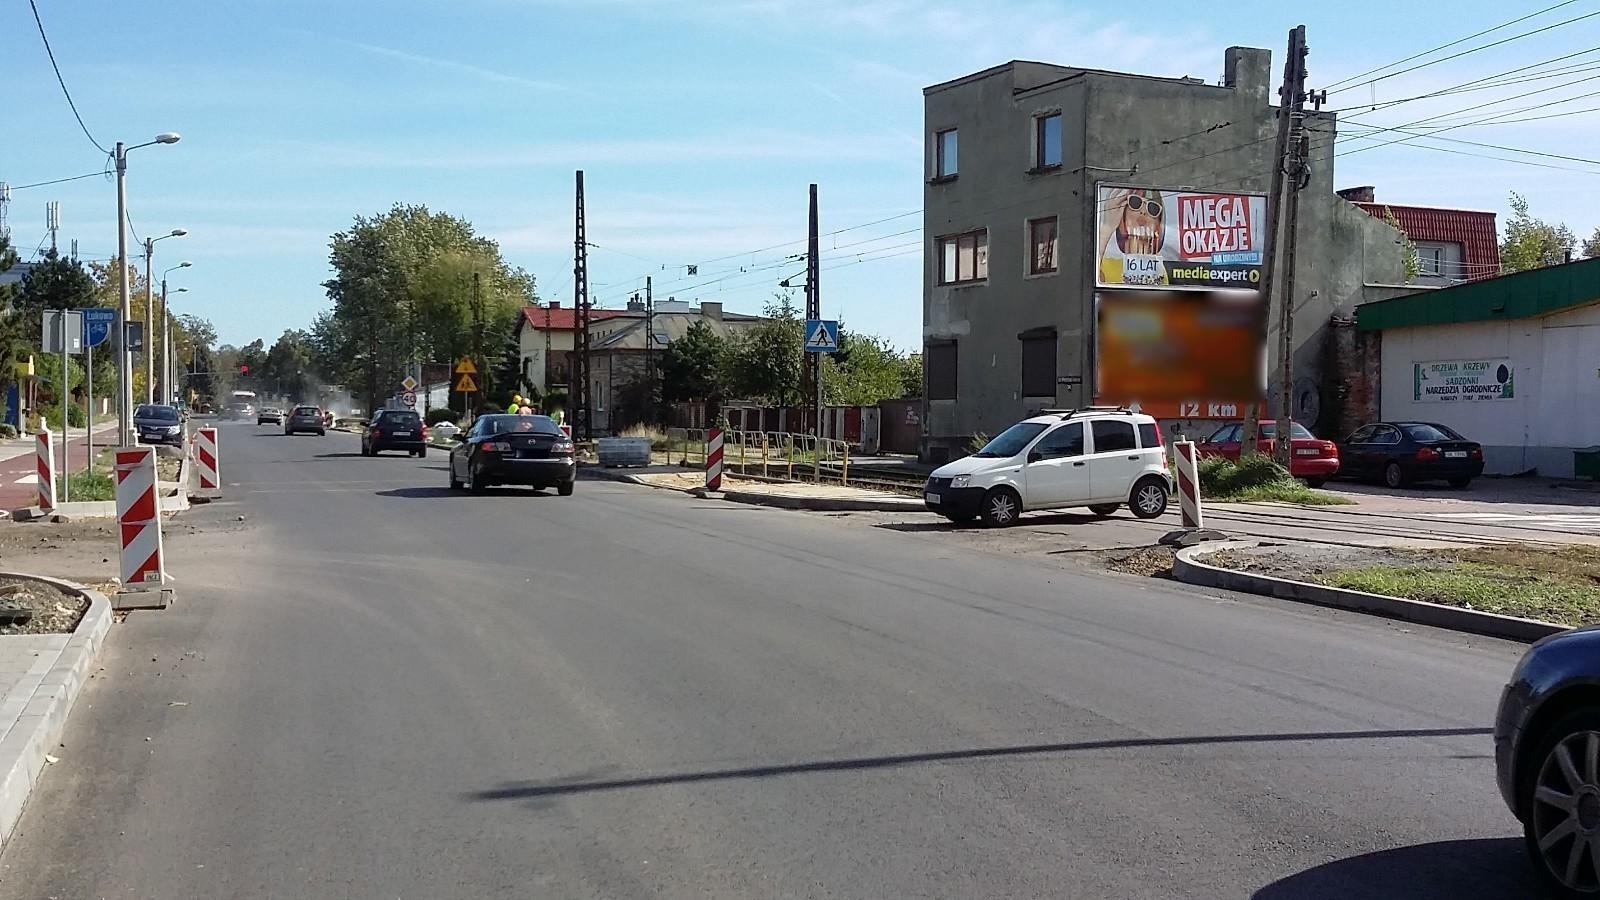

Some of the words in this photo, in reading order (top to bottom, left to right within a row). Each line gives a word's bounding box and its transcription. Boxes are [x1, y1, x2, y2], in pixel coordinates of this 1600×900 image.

[1183, 197, 1246, 229] MEGA
[1183, 228, 1249, 254] OKAZJE
[1127, 258, 1137, 271] 16
[1140, 259, 1159, 271] LAT
[1172, 266, 1248, 282] mediaexpert
[1431, 363, 1458, 372] DRZEWA
[1463, 362, 1490, 371] KRZEWY
[1445, 376, 1479, 385] SADZONKI
[1462, 384, 1502, 394] OGRODNICZE
[403, 395, 414, 403] 40
[1180, 401, 1200, 417] 12
[1208, 402, 1237, 417] km
